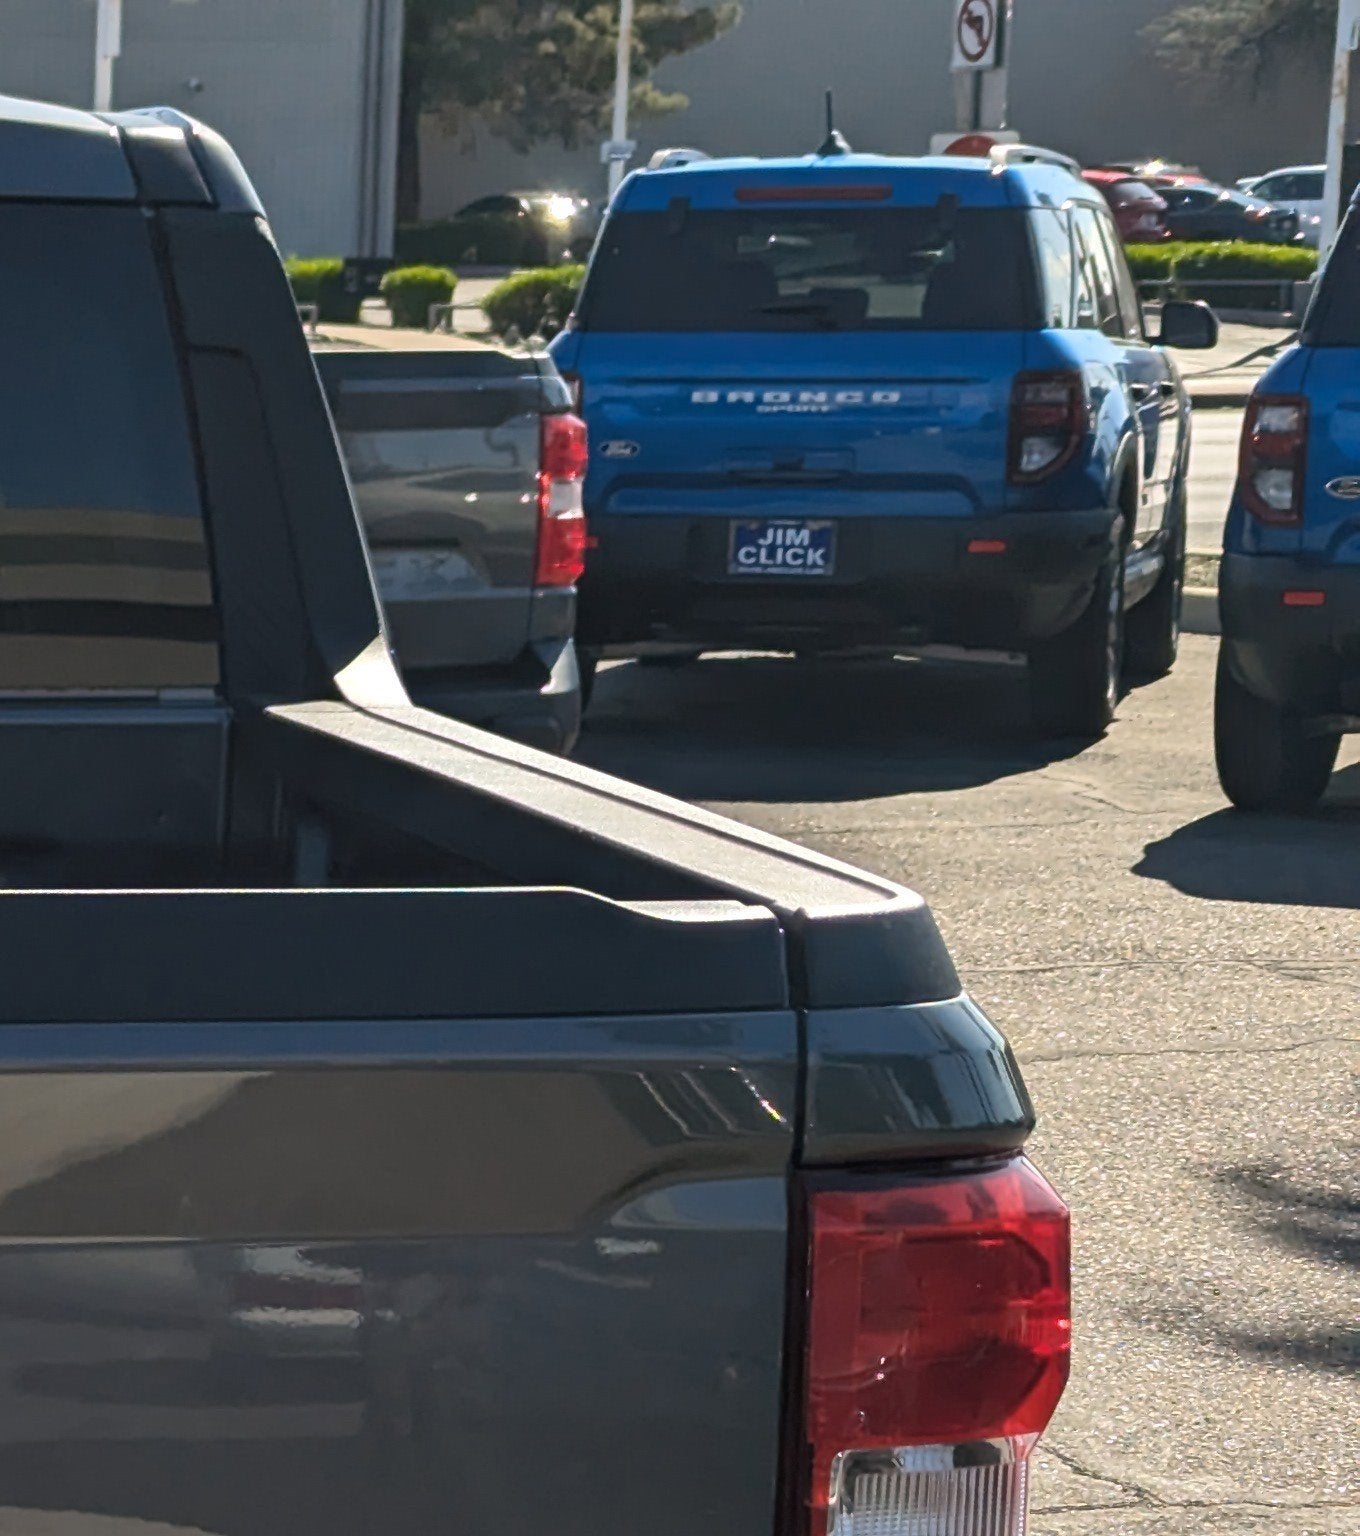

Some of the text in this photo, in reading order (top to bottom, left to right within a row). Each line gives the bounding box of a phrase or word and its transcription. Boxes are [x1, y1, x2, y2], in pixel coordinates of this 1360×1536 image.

[691, 389, 902, 404] BRONCO
[757, 527, 811, 546] JIM
[737, 546, 827, 566] CLICK
